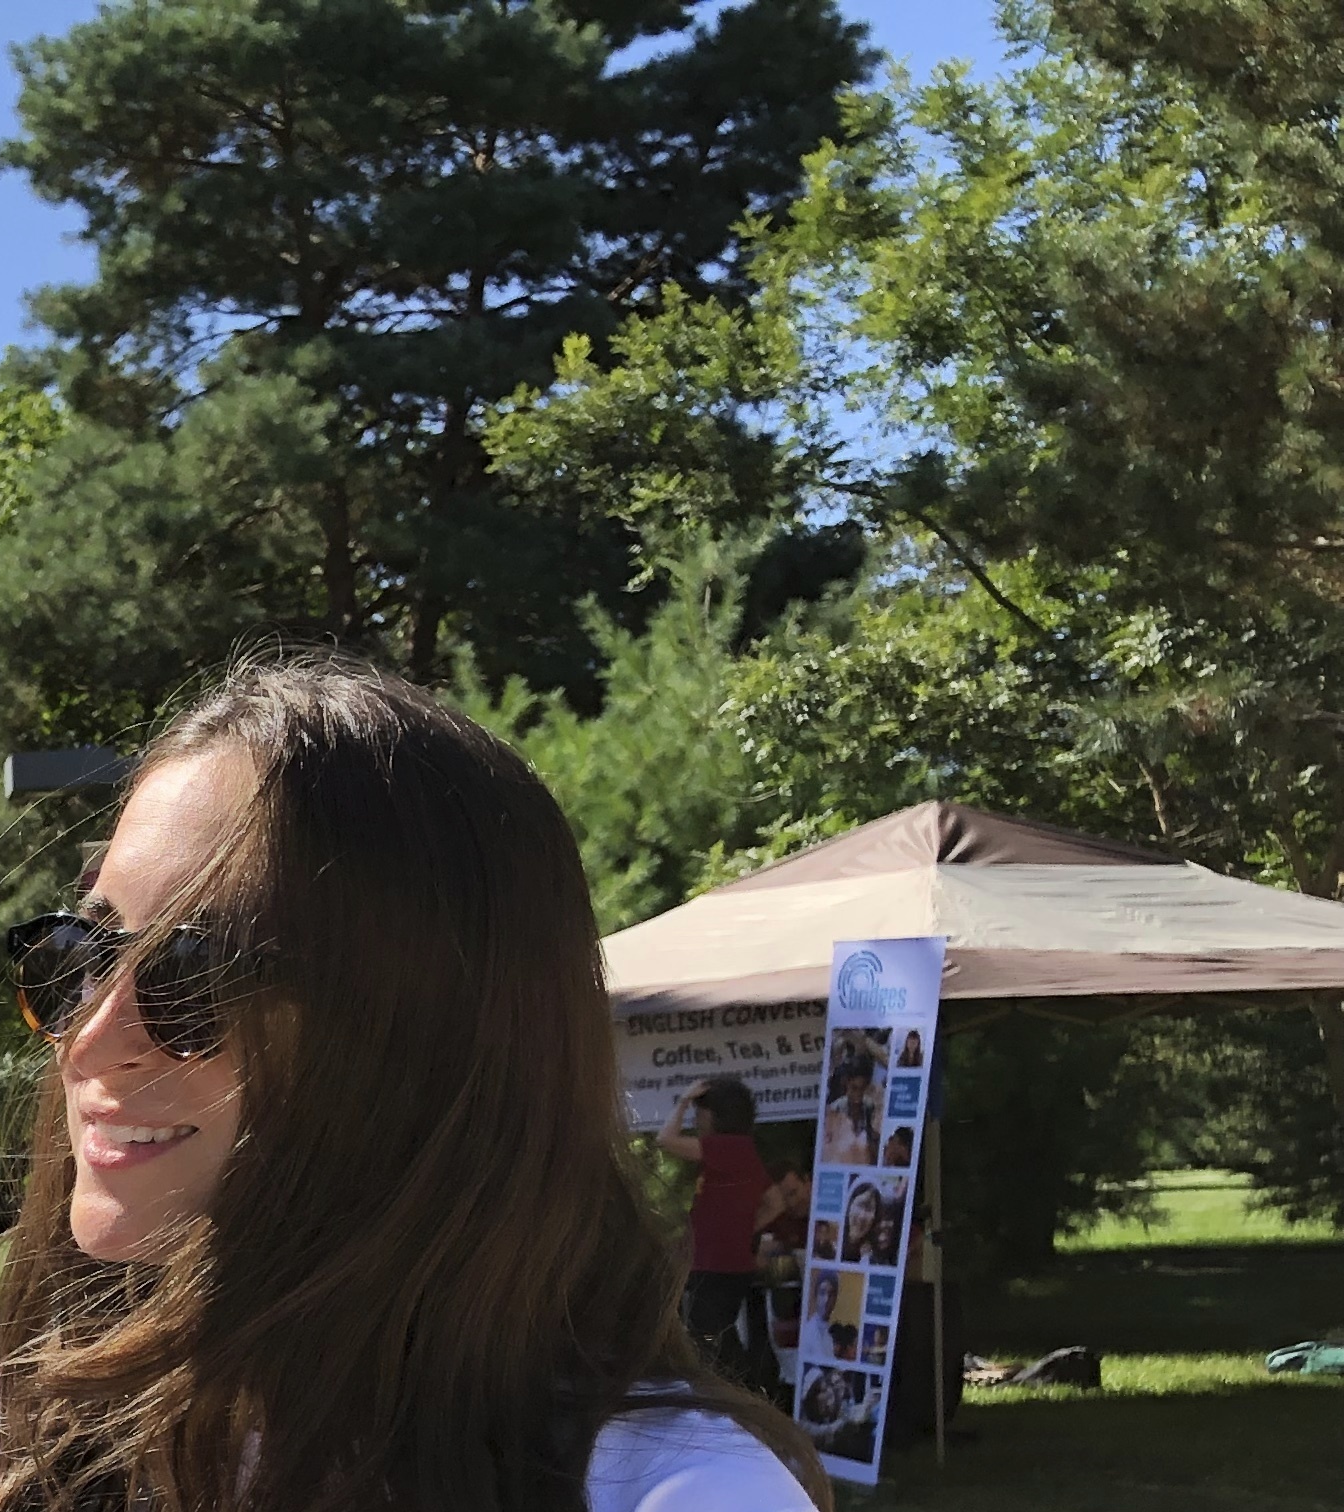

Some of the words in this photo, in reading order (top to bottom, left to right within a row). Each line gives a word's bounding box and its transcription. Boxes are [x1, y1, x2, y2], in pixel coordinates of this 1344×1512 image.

[627, 1009, 715, 1037] ENGLISH
[724, 1039, 770, 1060] Tea,
[775, 1034, 792, 1056] &
